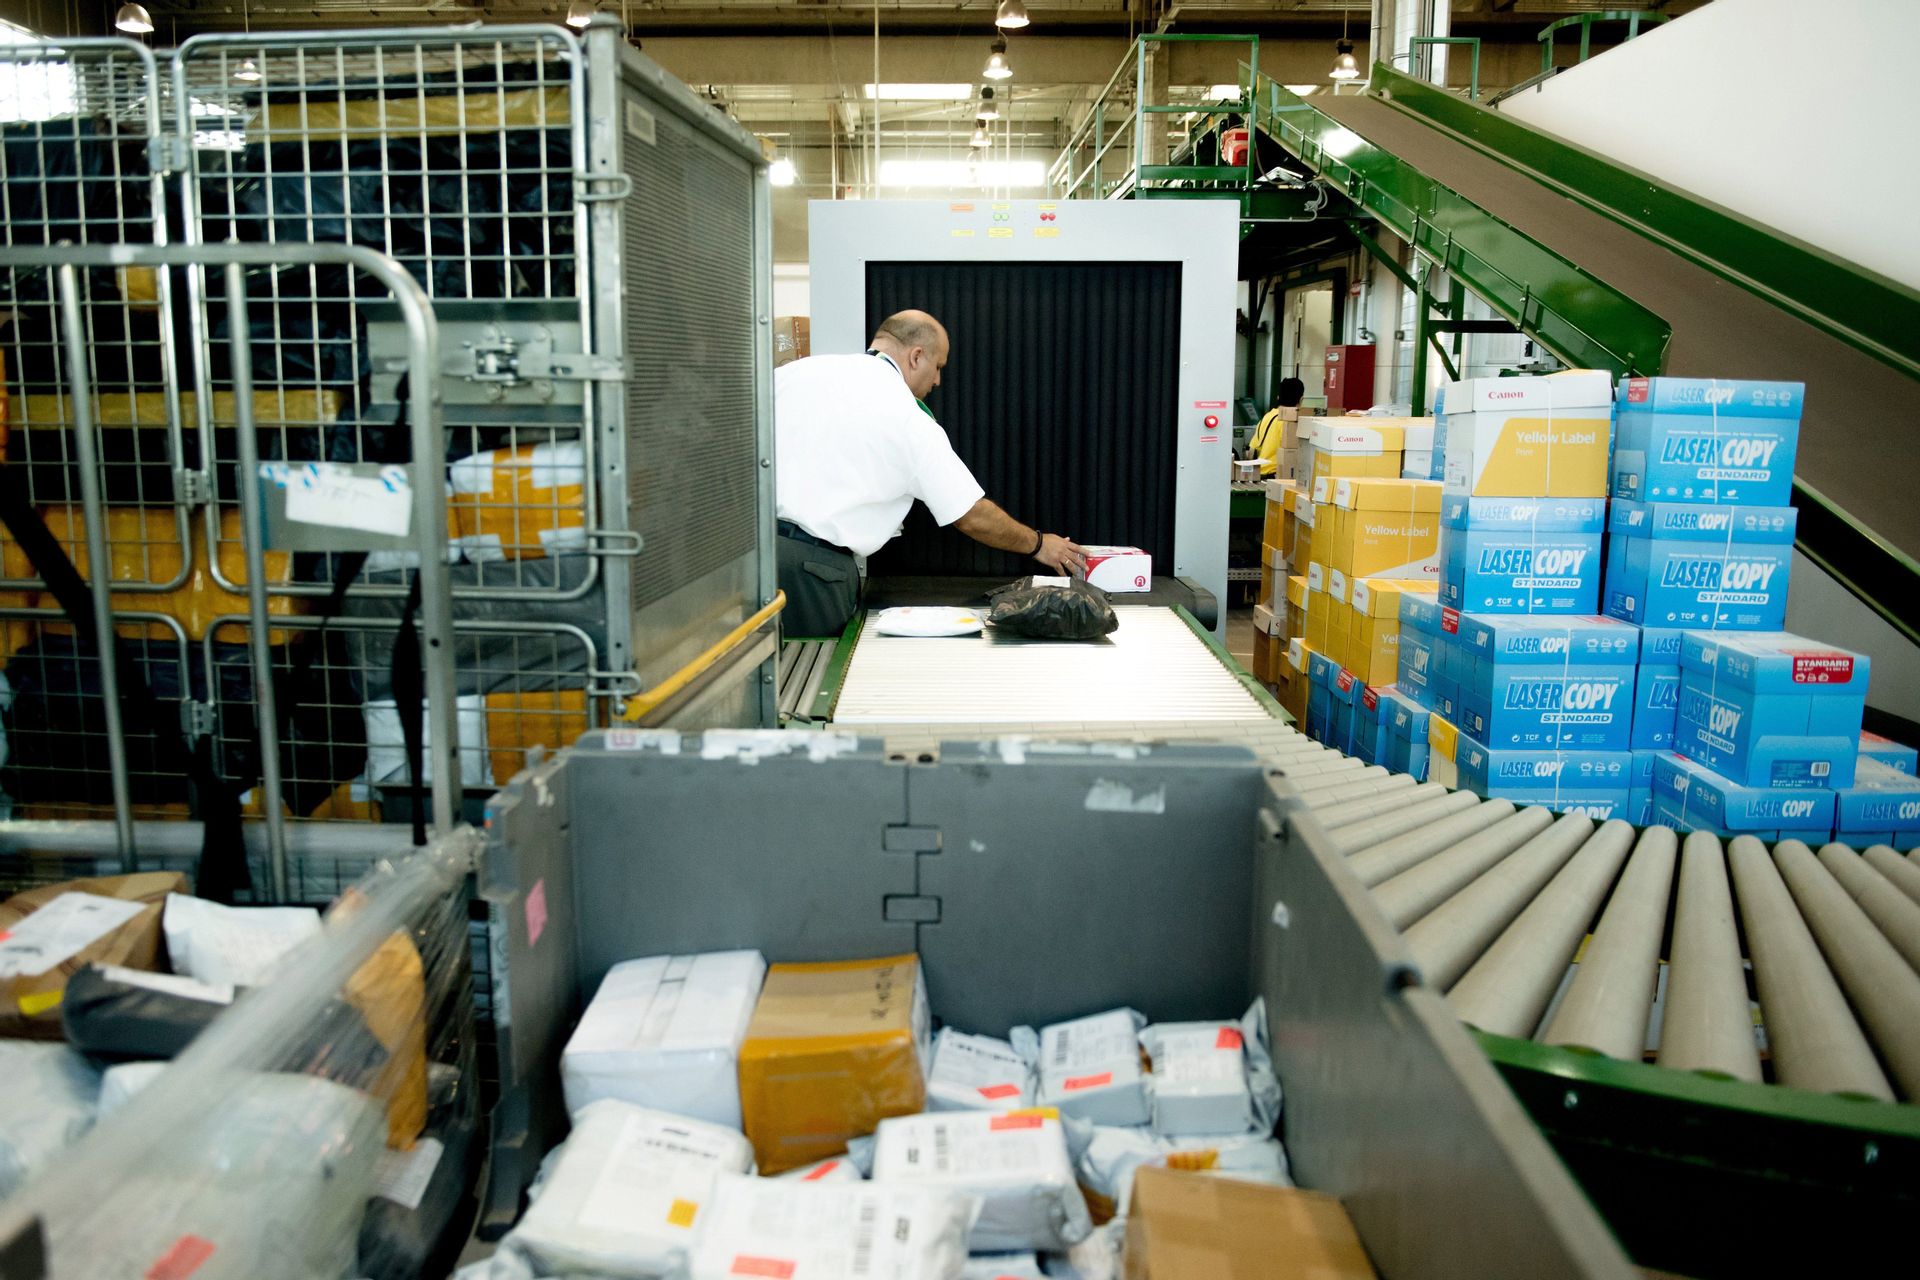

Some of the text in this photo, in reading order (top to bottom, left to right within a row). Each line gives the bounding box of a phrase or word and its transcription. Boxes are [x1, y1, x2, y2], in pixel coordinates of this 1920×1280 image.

[1488, 390, 1524, 400] Canon
[1671, 386, 1736, 405] LASER COPY
[1516, 431, 1596, 445] Yellow Label
[1660, 437, 1778, 467] LASER COPY
[1699, 469, 1769, 481] STANDARD
[1477, 505, 1512, 521] LASER
[1511, 505, 1541, 521] COPY
[1663, 513, 1730, 530] LASER COPY
[1364, 524, 1429, 537] Yellow Label
[1477, 548, 1587, 576] LASER COPY
[1514, 578, 1580, 588] STANDARD
[1660, 560, 1777, 590] LASER COPY
[1497, 597, 1512, 605] TCF
[1699, 593, 1767, 603] STANDARD
[1680, 612, 1696, 620] TCF
[1505, 637, 1570, 653] LASER COPY
[1797, 659, 1850, 667] STANDARD
[1504, 682, 1619, 710] LASER COPY
[1542, 714, 1611, 723] STANDARD
[1709, 704, 1741, 739] COPY
[1525, 733, 1540, 741] TCF
[1699, 731, 1735, 753] STANDARD
[1499, 761, 1566, 778] LASER COPY
[1745, 800, 1816, 818] LASER COPY
